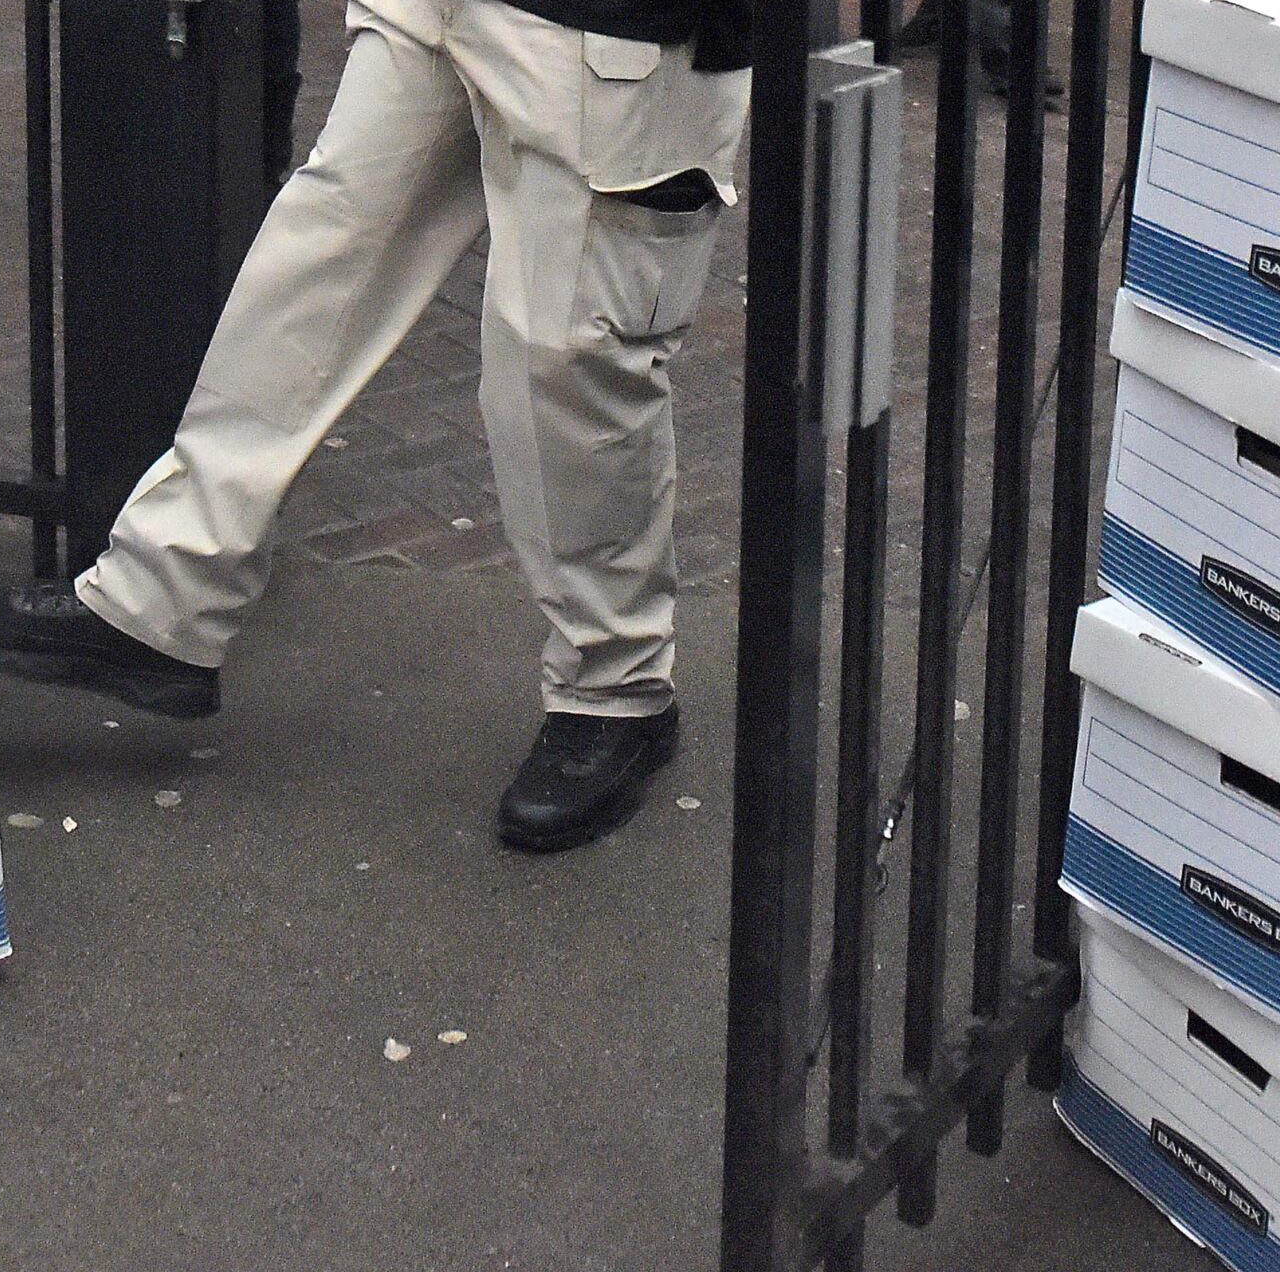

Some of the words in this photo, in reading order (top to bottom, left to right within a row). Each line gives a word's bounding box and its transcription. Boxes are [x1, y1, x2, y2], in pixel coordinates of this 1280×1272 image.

[1207, 568, 1280, 622] BANKERS
[1190, 877, 1272, 936] BANKERS
[1158, 1129, 1227, 1196] BANKERS
[1229, 1189, 1260, 1226] BOX
